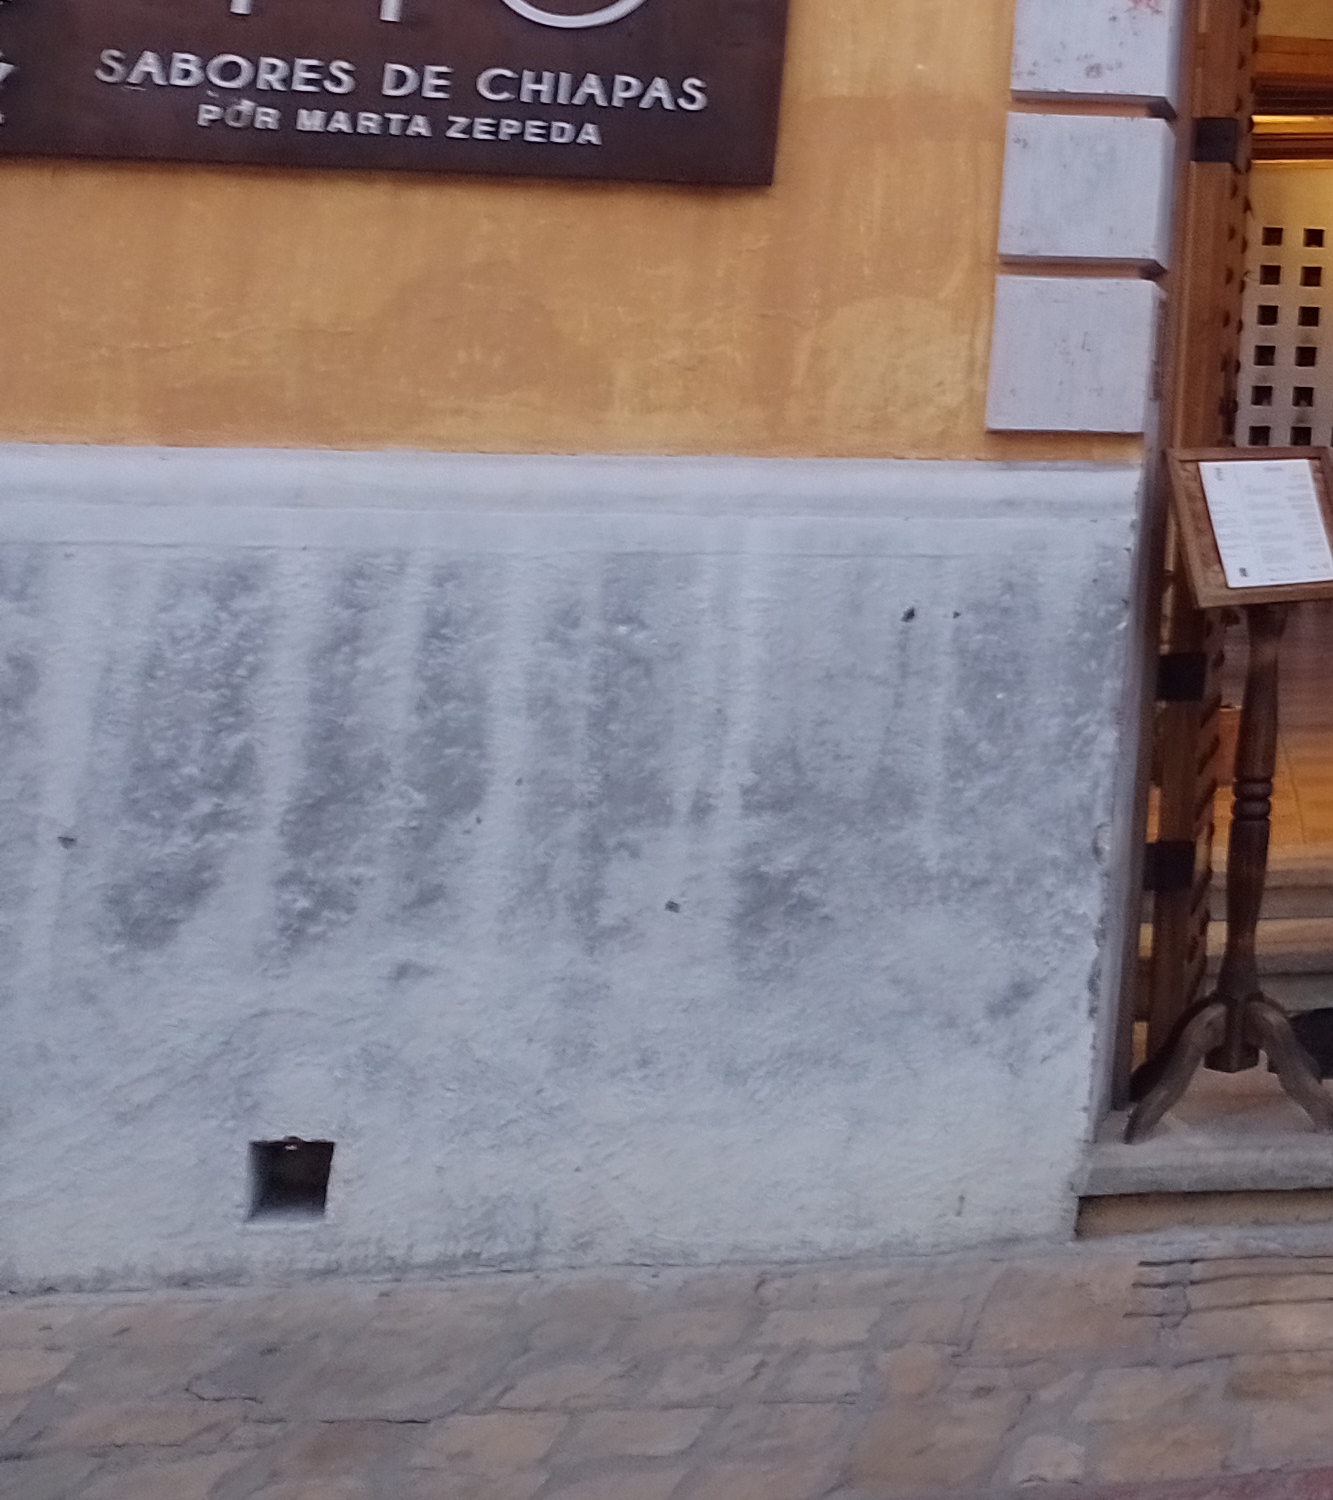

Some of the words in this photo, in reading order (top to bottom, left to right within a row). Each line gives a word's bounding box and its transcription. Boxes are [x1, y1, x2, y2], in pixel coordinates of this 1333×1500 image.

[94, 48, 355, 97] SABORES
[383, 61, 453, 100] DE
[476, 66, 708, 112] CHIAPAS
[197, 99, 280, 131] POR
[296, 108, 432, 138] MARTA
[445, 115, 603, 146] ZEPEDA
